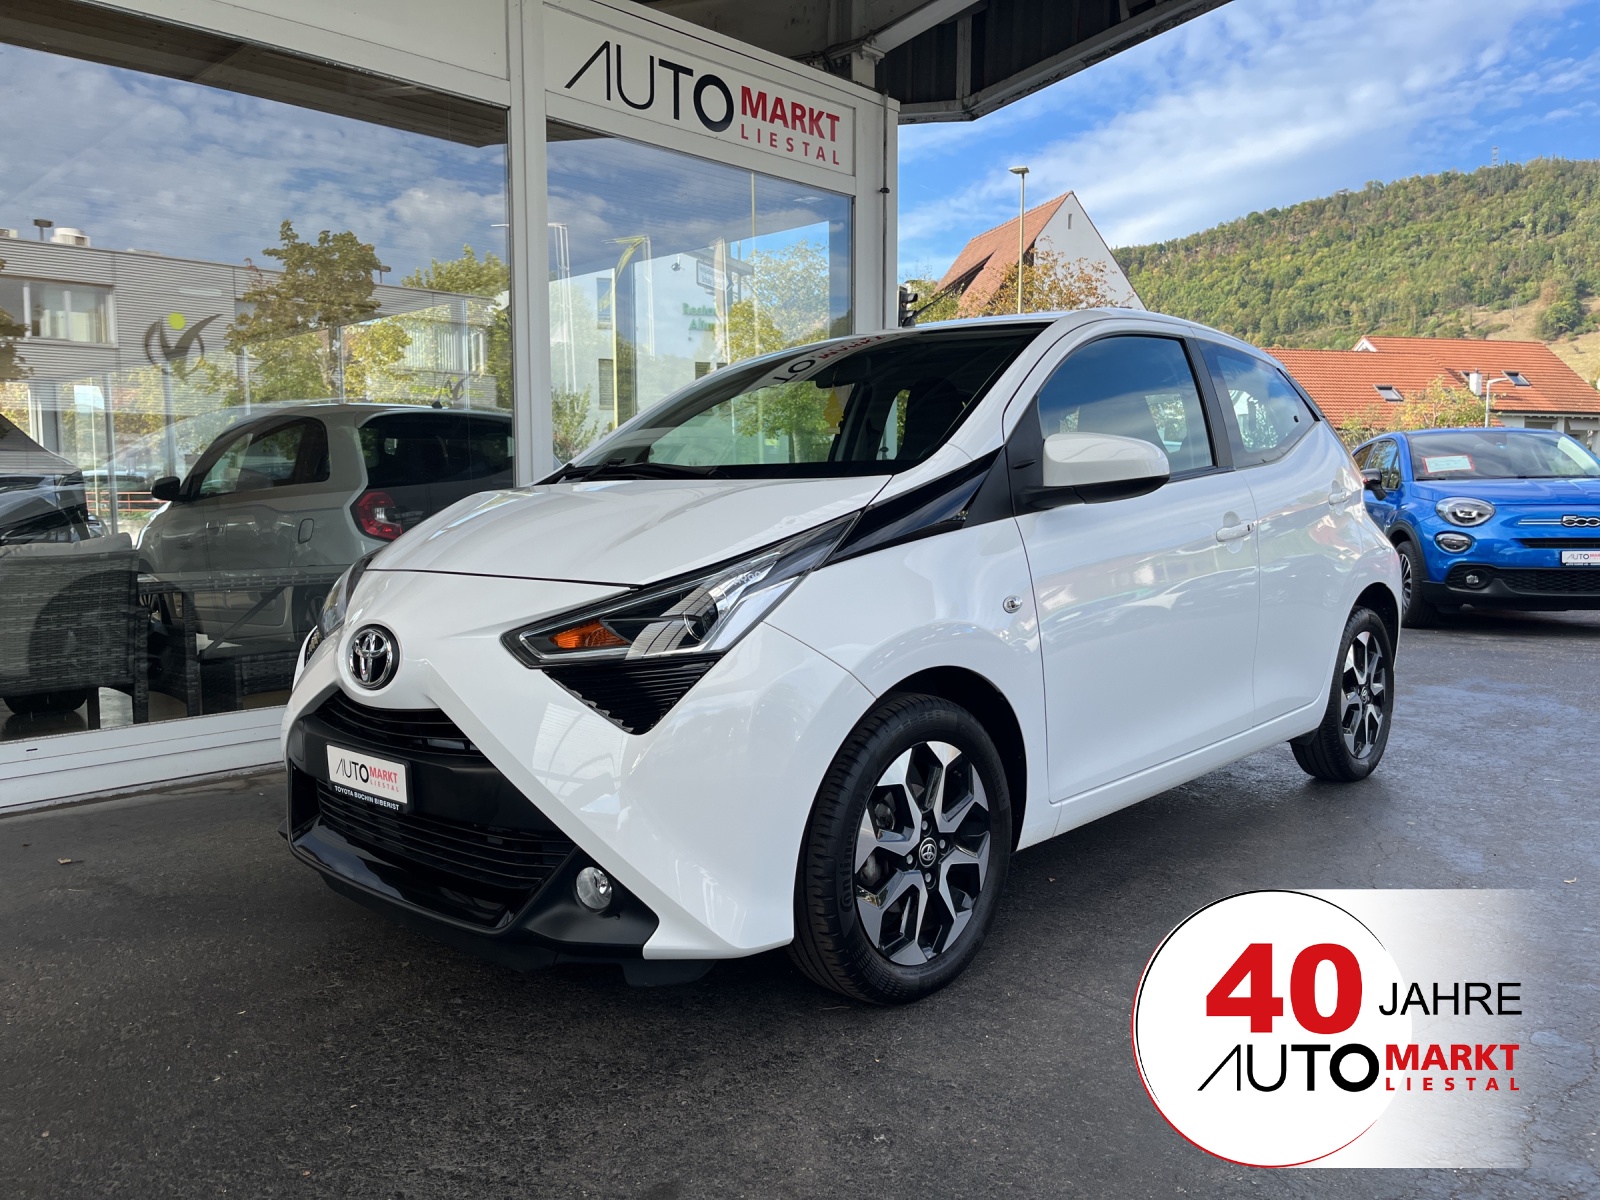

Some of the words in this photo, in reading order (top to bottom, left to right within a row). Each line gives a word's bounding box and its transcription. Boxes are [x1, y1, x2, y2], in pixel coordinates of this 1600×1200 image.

[564, 40, 734, 132] AUTO
[740, 85, 840, 143] MARKT
[740, 123, 840, 166] LIESTAL
[336, 758, 369, 783] AUTO
[369, 766, 398, 784] MARKT
[334, 785, 354, 796] TOYOTA
[374, 797, 400, 810] BIBERIST
[370, 780, 399, 793] LIESTAL
